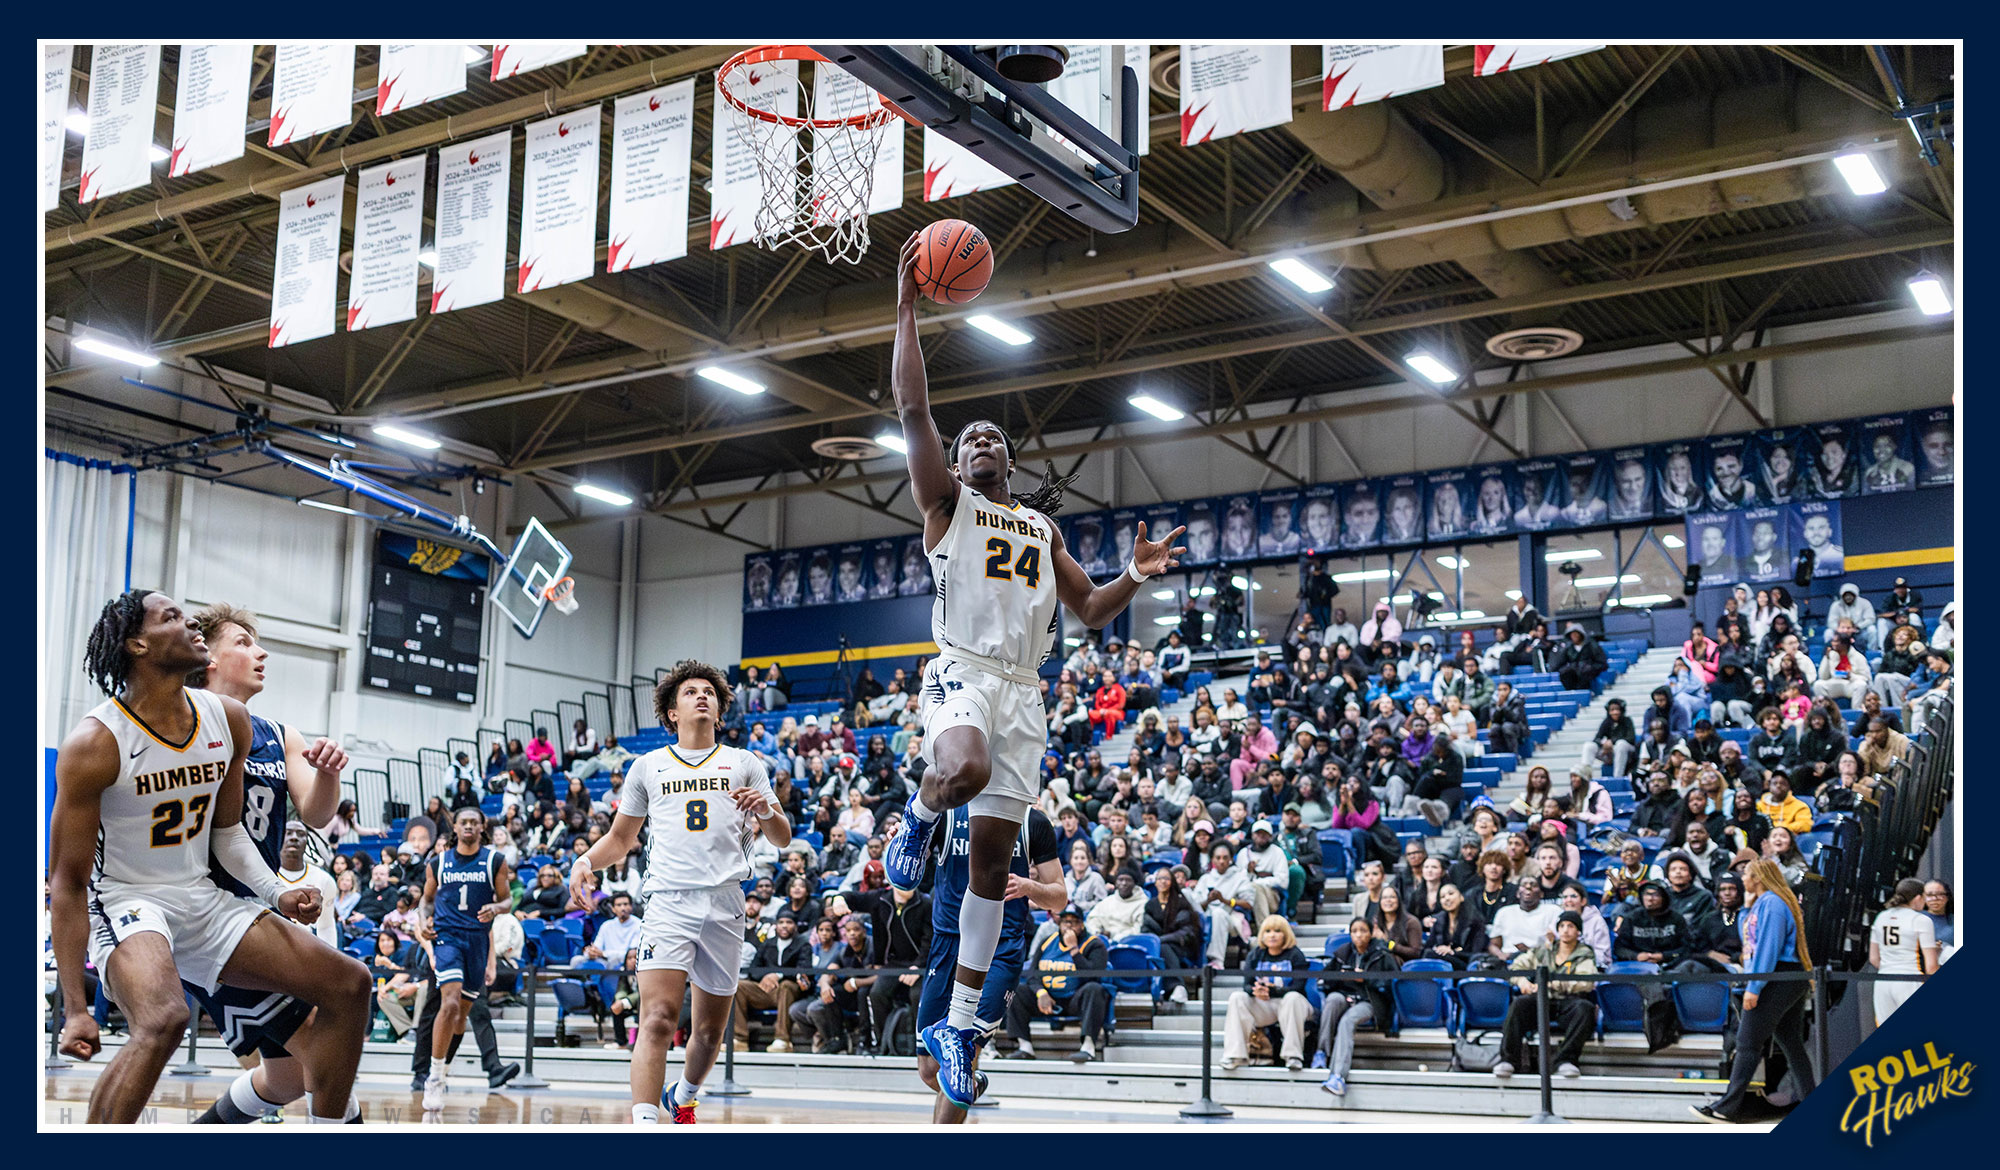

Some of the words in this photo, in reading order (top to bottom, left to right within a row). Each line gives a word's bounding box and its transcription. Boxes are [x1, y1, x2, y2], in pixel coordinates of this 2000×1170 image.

[651, 113, 688, 129] NATIONAL
[560, 139, 593, 154] NATIONAL
[470, 160, 501, 175] NATIONAL
[974, 508, 1050, 544] HUMBER
[984, 536, 1041, 590] 24
[134, 760, 227, 796] HUMBER
[661, 777, 731, 796] HUMBER
[150, 793, 212, 849] 23
[245, 784, 276, 842] 8
[685, 798, 709, 832] 8
[442, 870, 487, 884] NIAGARA
[457, 884, 468, 911] 1
[1882, 925, 1900, 946] 15
